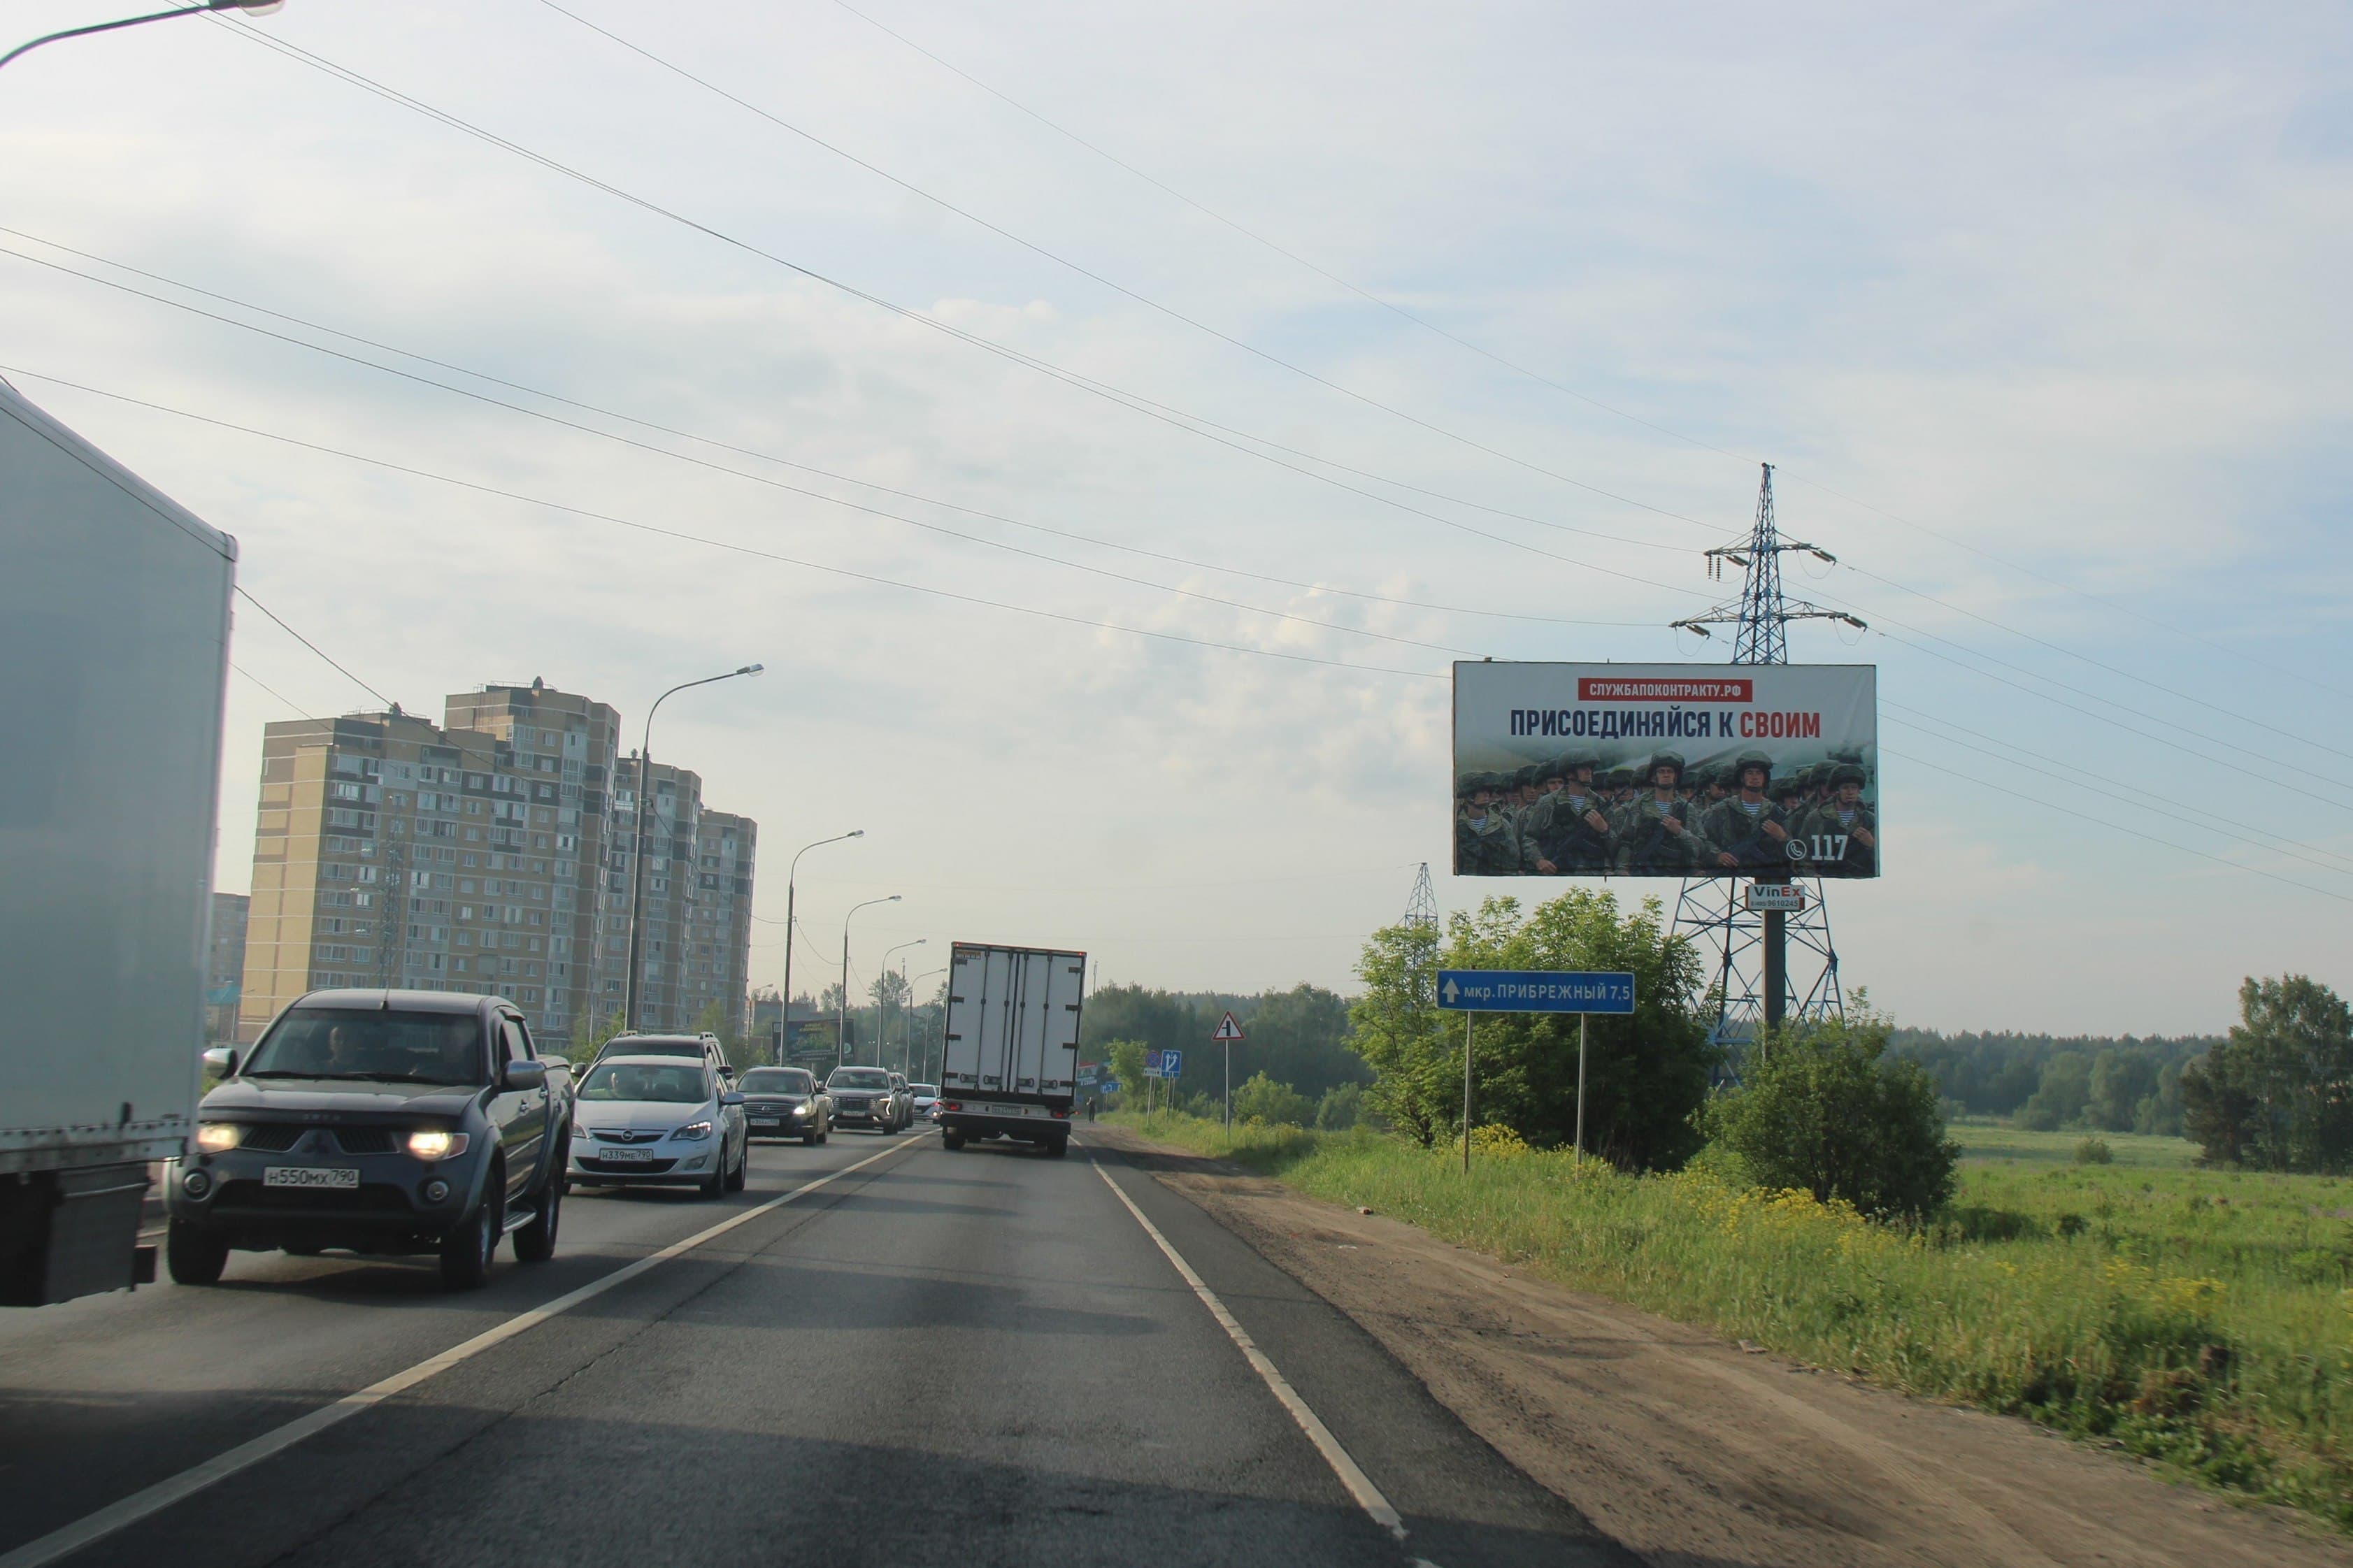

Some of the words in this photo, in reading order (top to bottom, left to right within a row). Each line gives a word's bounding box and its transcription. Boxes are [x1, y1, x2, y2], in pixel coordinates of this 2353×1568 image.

[1589, 683, 1741, 698] СЛУЖБАПОКОНТРАКТУ.РФ
[1510, 705, 1710, 739] ПРИСОЕДИНЯЙСЯ
[1719, 712, 1733, 738] К
[1740, 712, 1820, 738] СВОИМ
[1811, 835, 1848, 861] 117
[1754, 886, 1800, 897] VinEx
